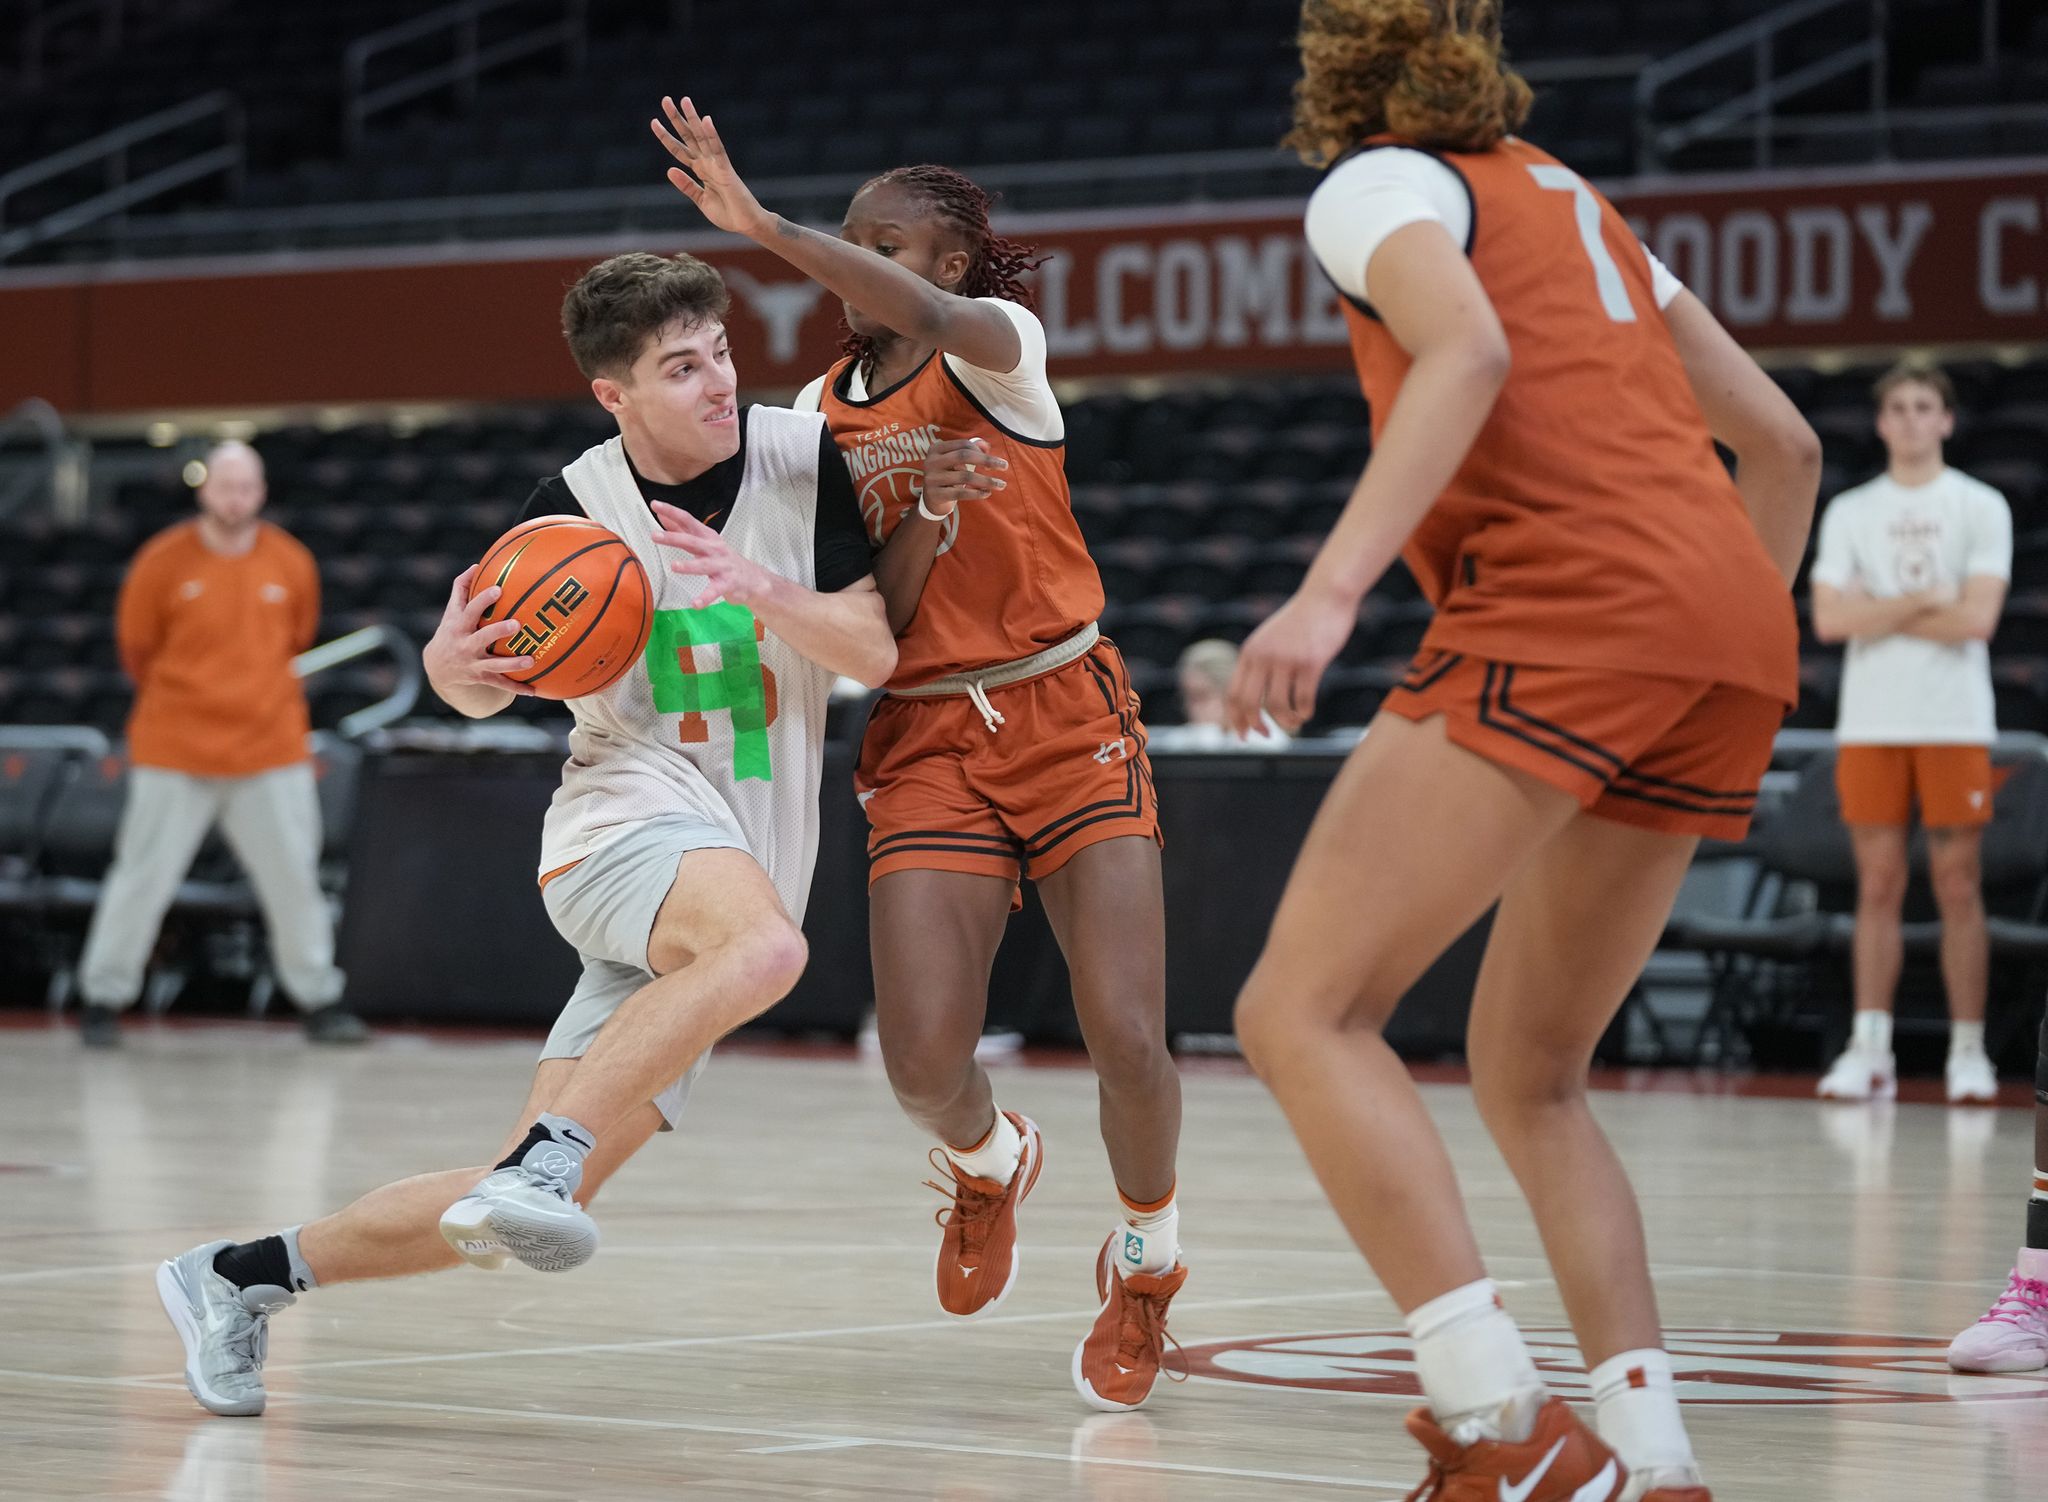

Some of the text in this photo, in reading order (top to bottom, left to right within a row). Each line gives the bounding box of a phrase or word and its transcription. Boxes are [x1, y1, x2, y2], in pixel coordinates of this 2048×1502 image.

[1042, 236, 1349, 356] LCOME
[1632, 200, 1932, 323] OODY
[1526, 164, 1637, 322] 7
[856, 423, 899, 443] TEXAS
[506, 575, 590, 656] ELITE
